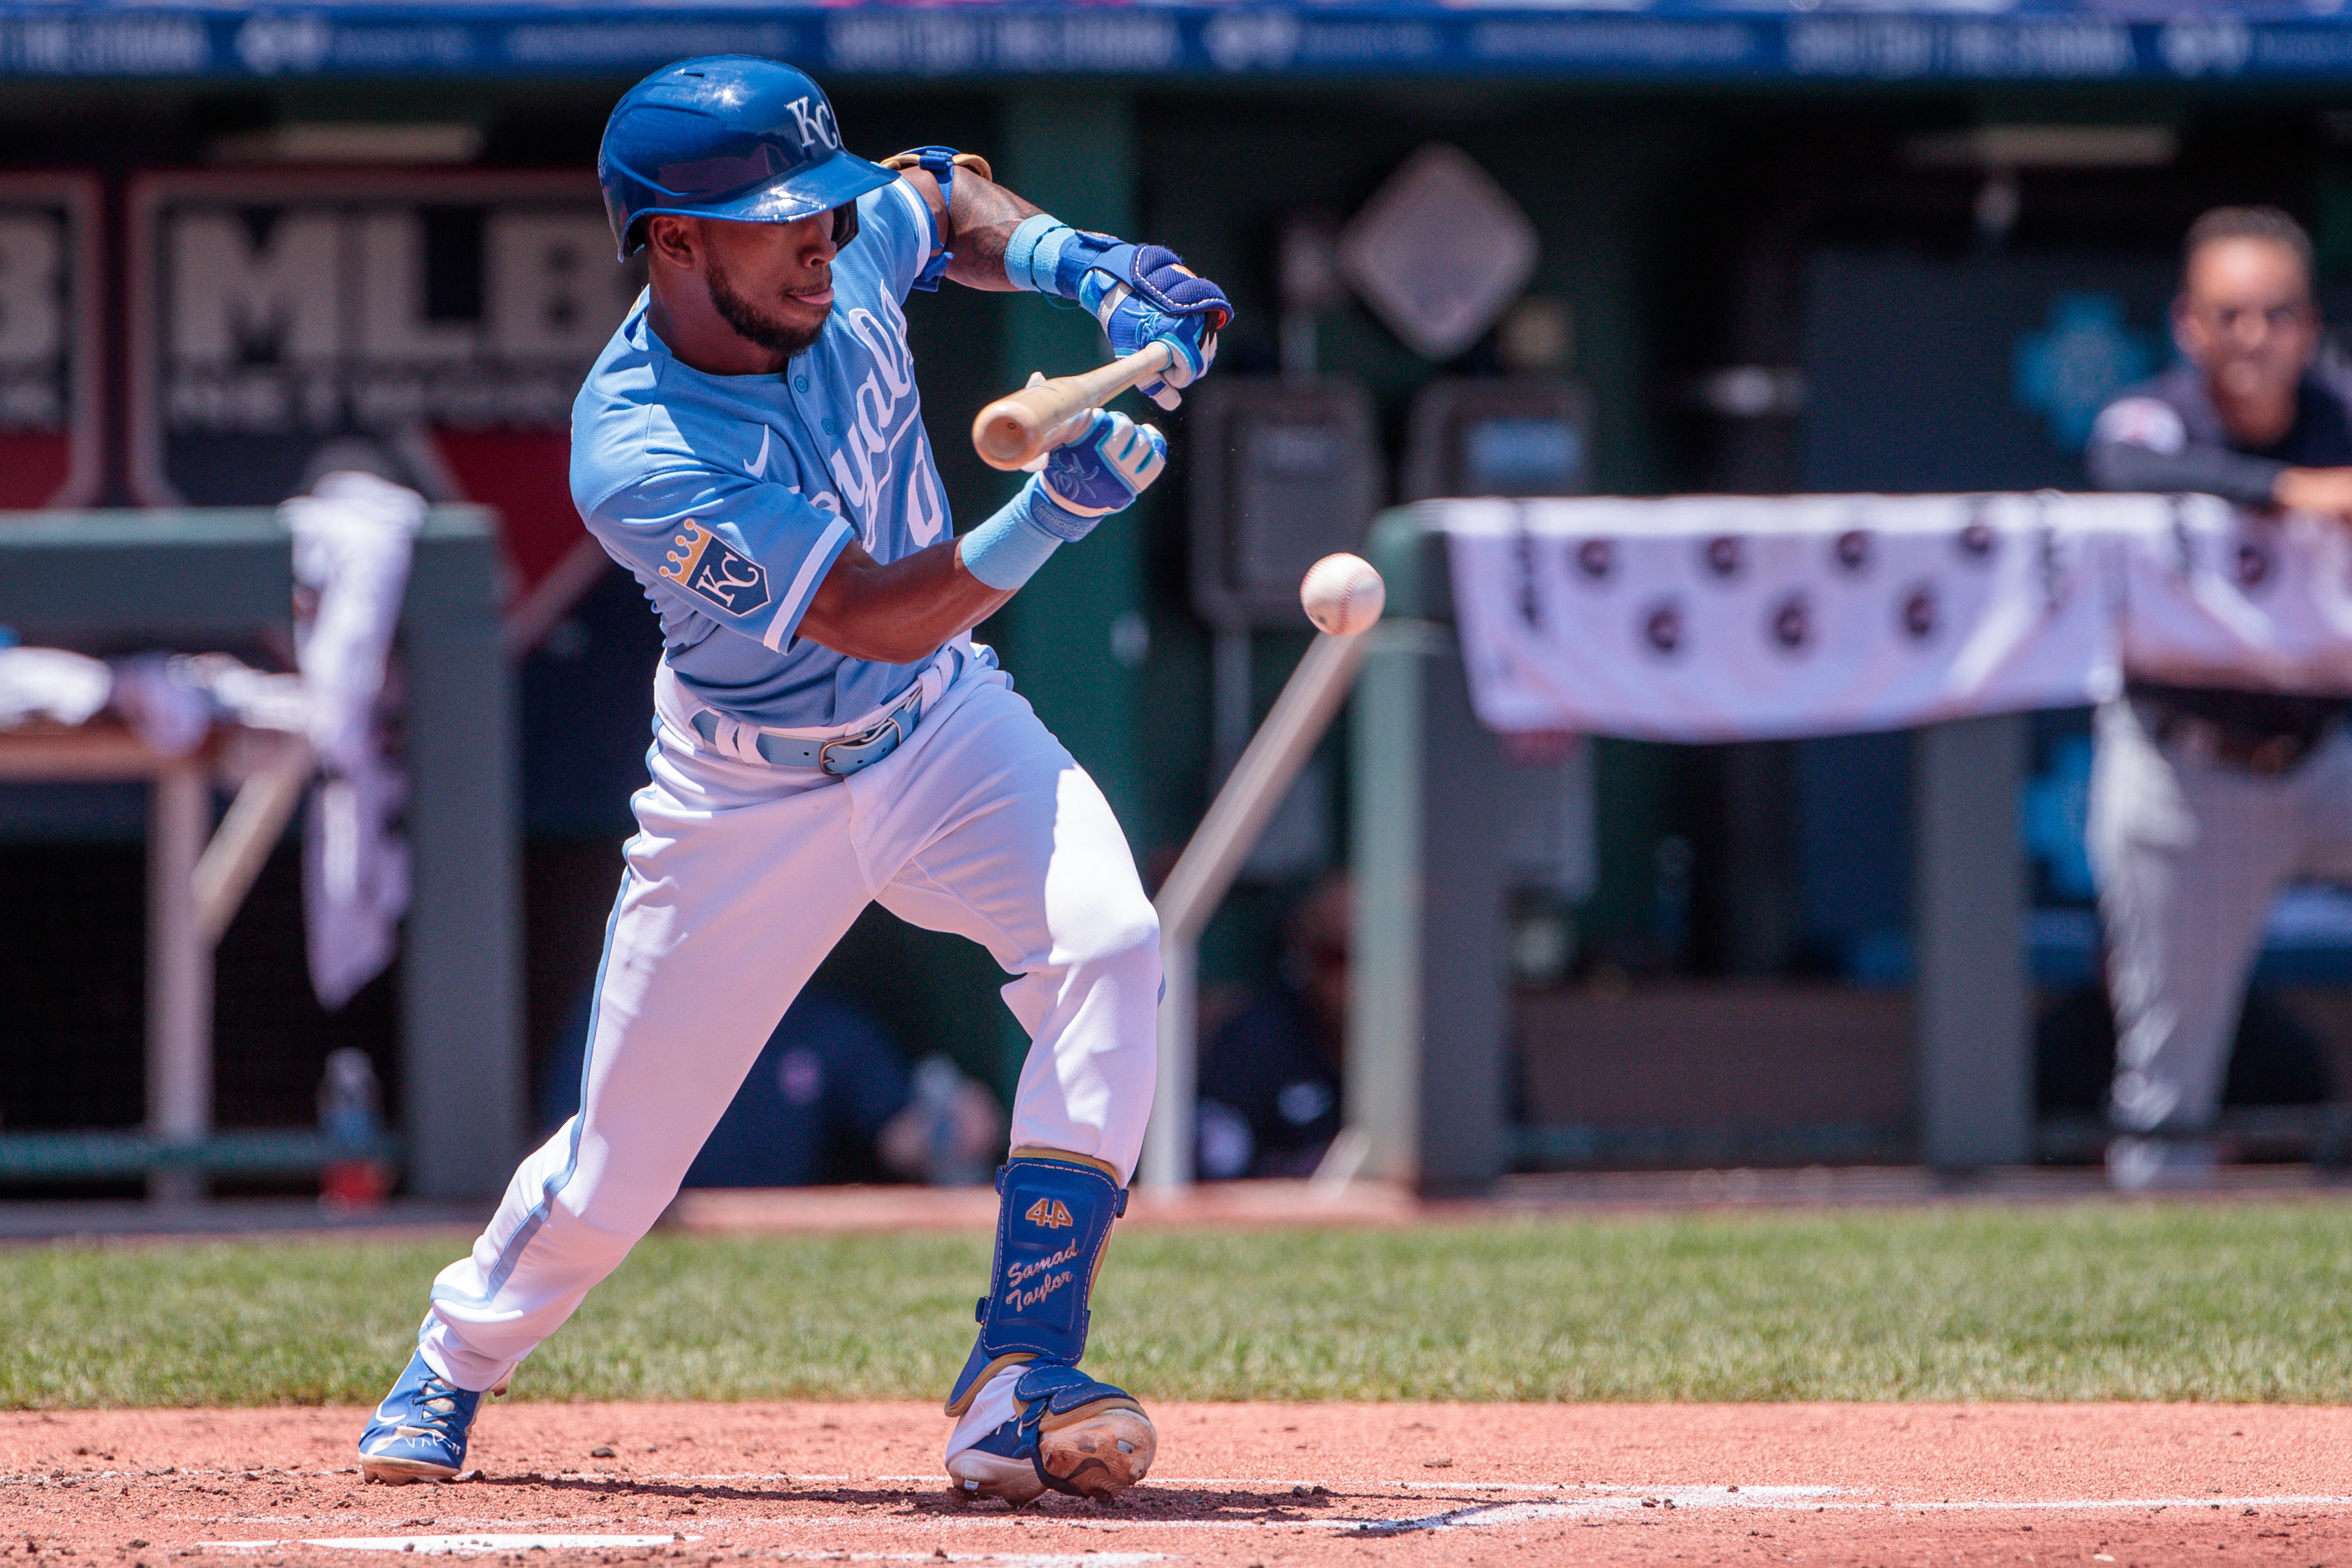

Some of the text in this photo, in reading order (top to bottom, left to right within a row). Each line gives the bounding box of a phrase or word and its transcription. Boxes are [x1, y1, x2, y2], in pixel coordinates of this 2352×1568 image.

[784, 94, 838, 150] KC
[171, 211, 621, 356] MLB
[696, 551, 760, 607] KC
[1005, 1270, 1074, 1312] Taylor
[1007, 1238, 1080, 1288] Samad
